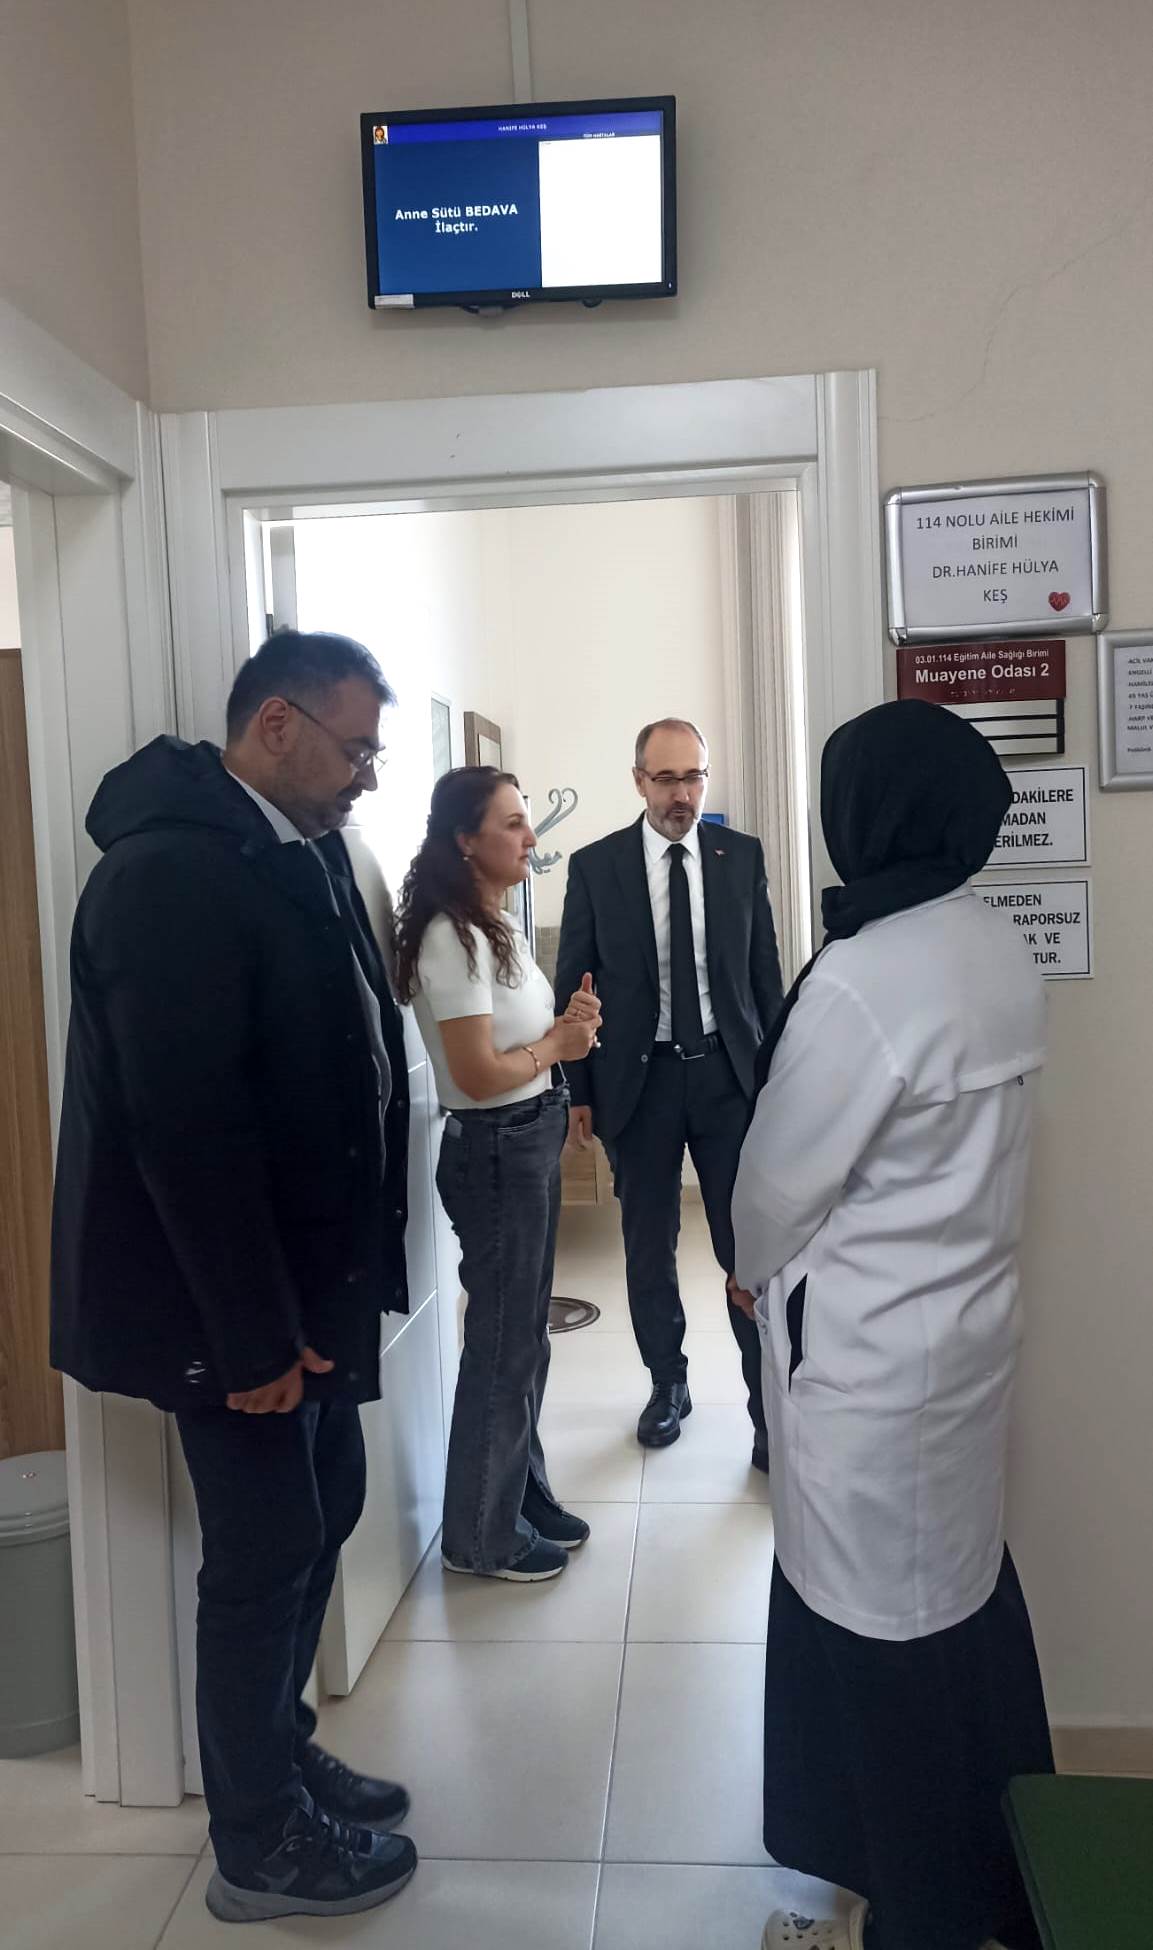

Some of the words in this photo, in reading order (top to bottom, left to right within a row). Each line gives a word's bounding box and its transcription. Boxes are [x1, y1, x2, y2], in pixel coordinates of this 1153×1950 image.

[395, 209, 428, 220] Anne
[431, 206, 461, 218] Sütü
[465, 203, 518, 217] BEDAVA
[435, 220, 479, 234] İlaçtır.
[916, 516, 942, 529] 114
[946, 514, 985, 527] NOLU
[989, 510, 1019, 525] AİLE
[1023, 506, 1075, 523] HEKİMİ
[972, 533, 1018, 550] BİRİMİ
[932, 561, 1007, 578] DR.HANİFE
[1012, 558, 1059, 574] HÜLYA
[983, 588, 1008, 604] KEŞ
[915, 655, 952, 664] 03.01.114
[980, 651, 996, 660] Aile
[1026, 649, 1049, 658] Birimi
[915, 667, 986, 684] Muayene
[991, 664, 1036, 678] Odası
[1040, 663, 1050, 677] 2
[1011, 787, 1074, 804] DAKİLERE
[1003, 811, 1046, 826] MADAN
[996, 831, 1054, 848] ERİLMEZ.
[983, 894, 1042, 908] ELMEDEN
[1013, 912, 1080, 926] RAPORSUZ
[1044, 932, 1061, 944] VE
[1033, 952, 1061, 964] TUR.
